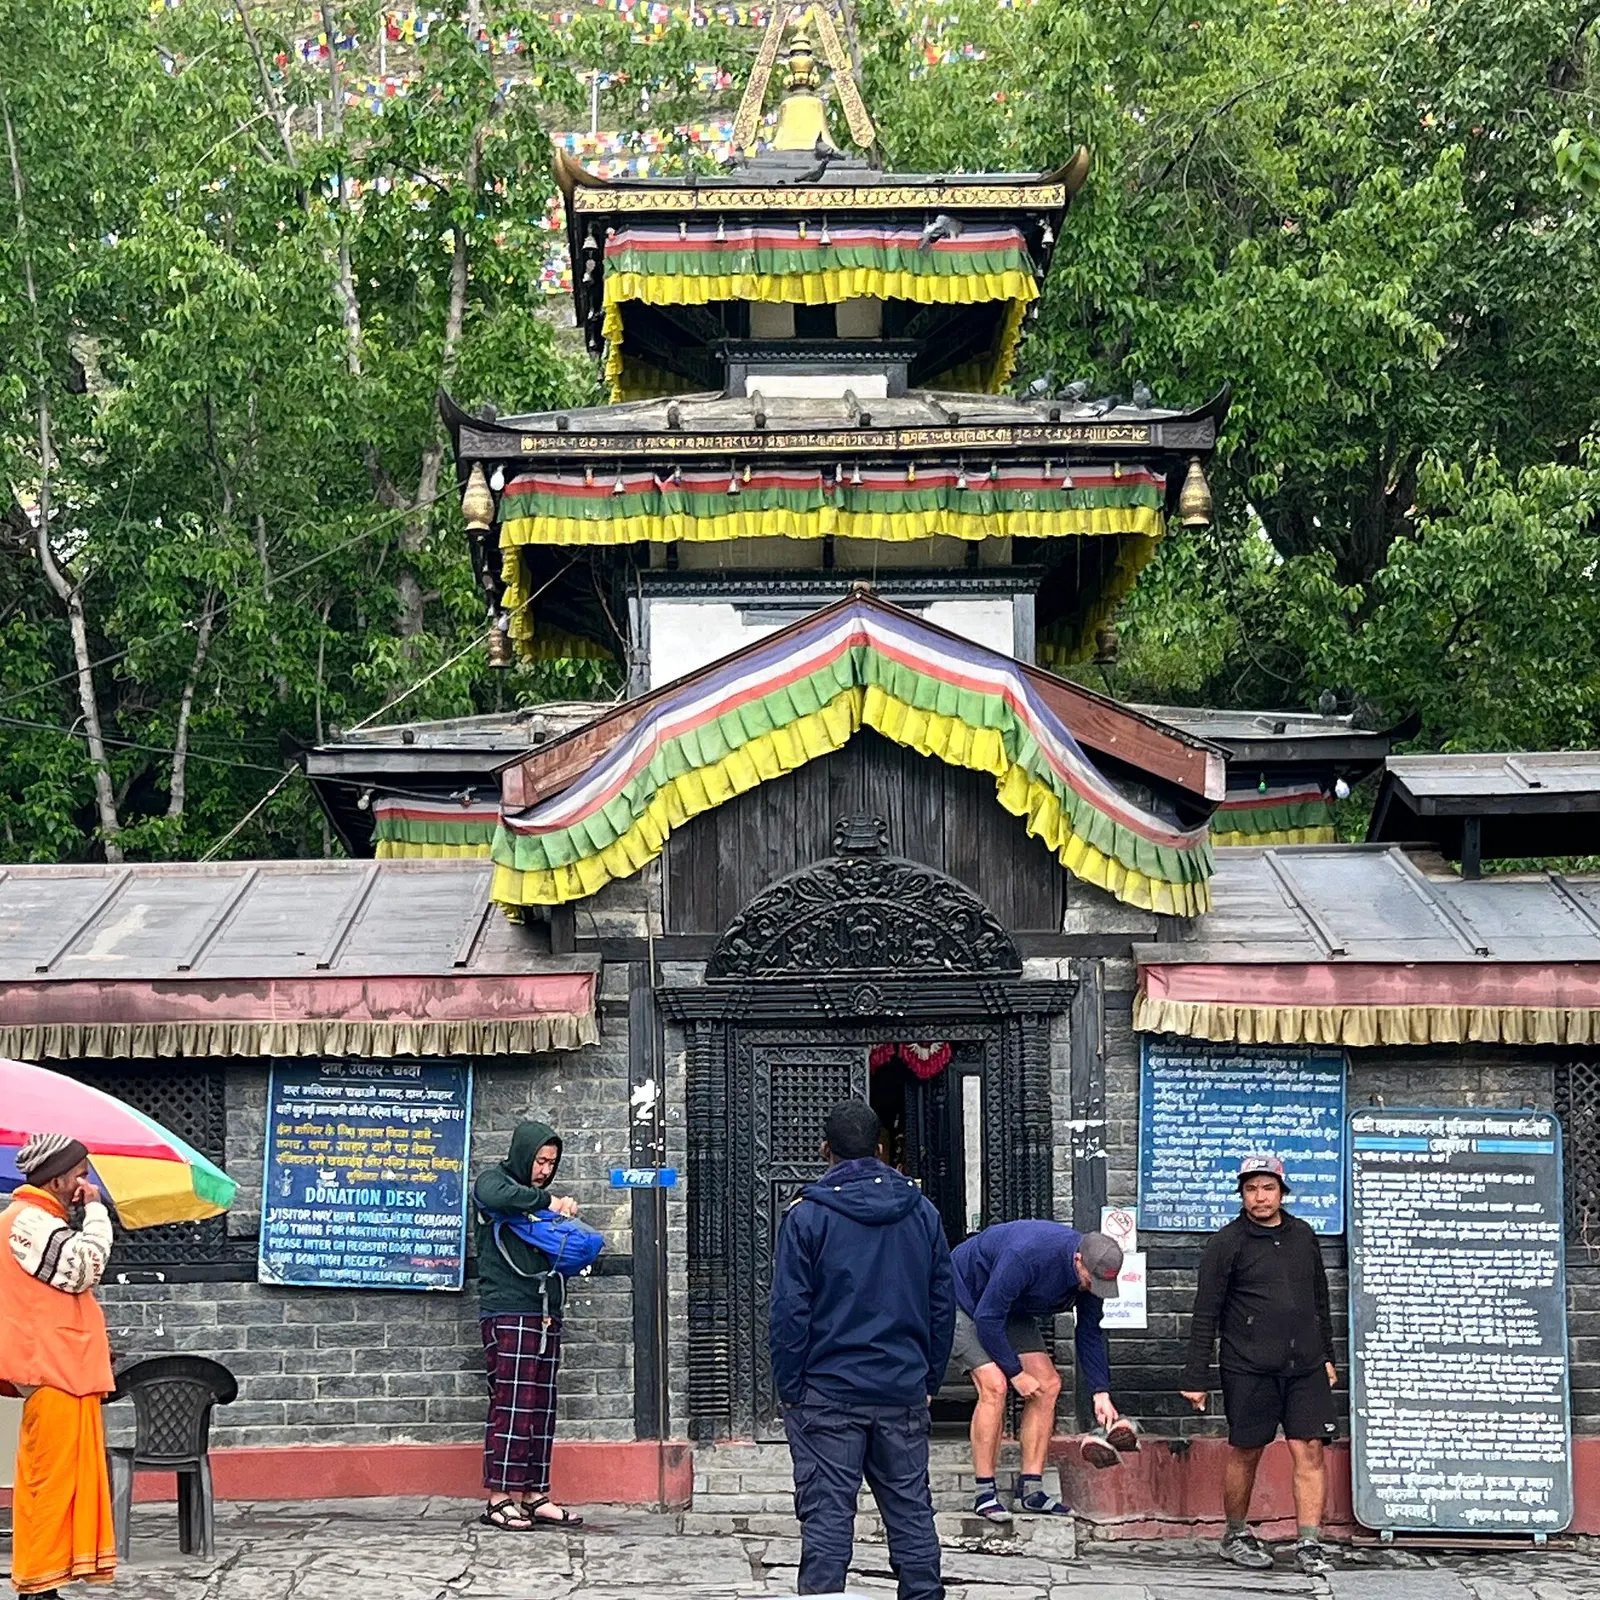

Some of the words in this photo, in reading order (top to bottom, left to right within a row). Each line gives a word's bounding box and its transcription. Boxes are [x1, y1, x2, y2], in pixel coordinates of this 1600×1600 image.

[305, 1187, 380, 1206] DONATION
[386, 1189, 427, 1208] DESK
[1158, 1215, 1206, 1227] INSIDE
[326, 1224, 345, 1236] FOR
[269, 1237, 303, 1249] PLEASE
[347, 1240, 388, 1253] REGISTER
[389, 1242, 412, 1254] BOOK
[414, 1243, 432, 1255] AND
[269, 1252, 293, 1263] YOUR
[295, 1253, 341, 1265] DONATION
